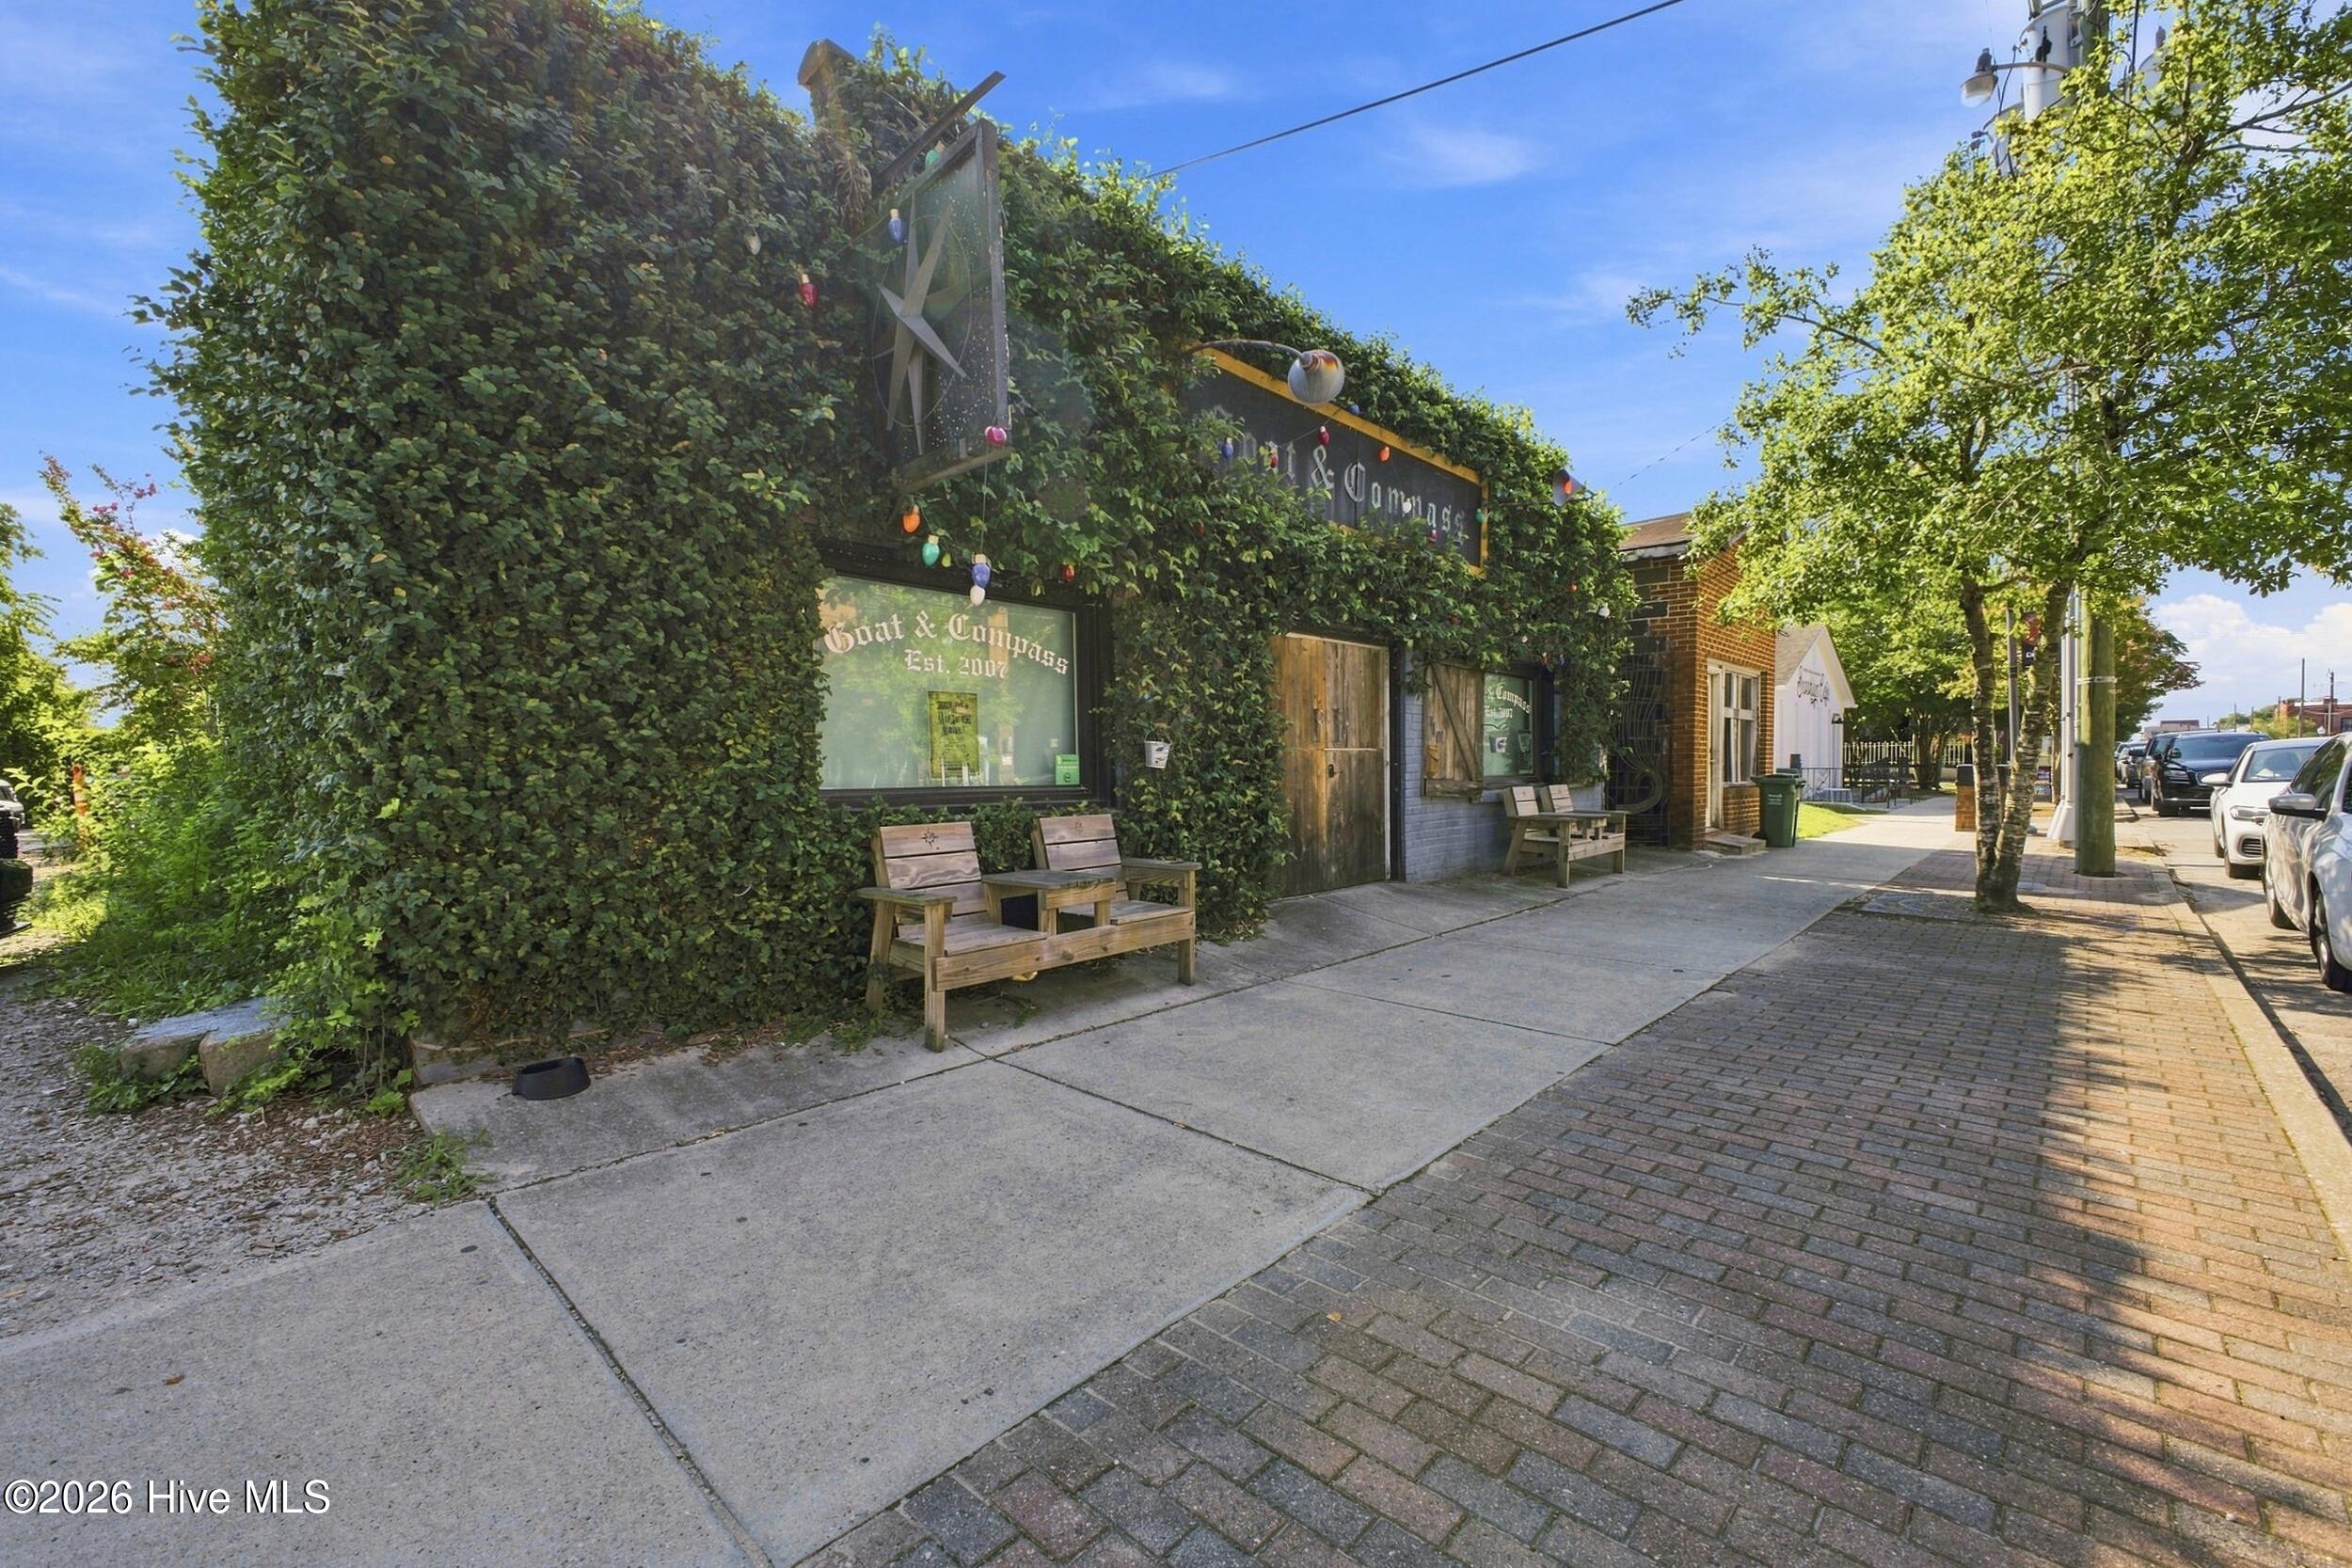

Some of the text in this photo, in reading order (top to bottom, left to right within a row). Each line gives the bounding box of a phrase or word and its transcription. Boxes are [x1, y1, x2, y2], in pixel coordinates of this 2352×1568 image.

[1310, 444, 1335, 490] &
[824, 610, 1070, 675] Goat & Compass
[904, 648, 1009, 678] Est. 2007
[1496, 681, 1531, 714] Compass
